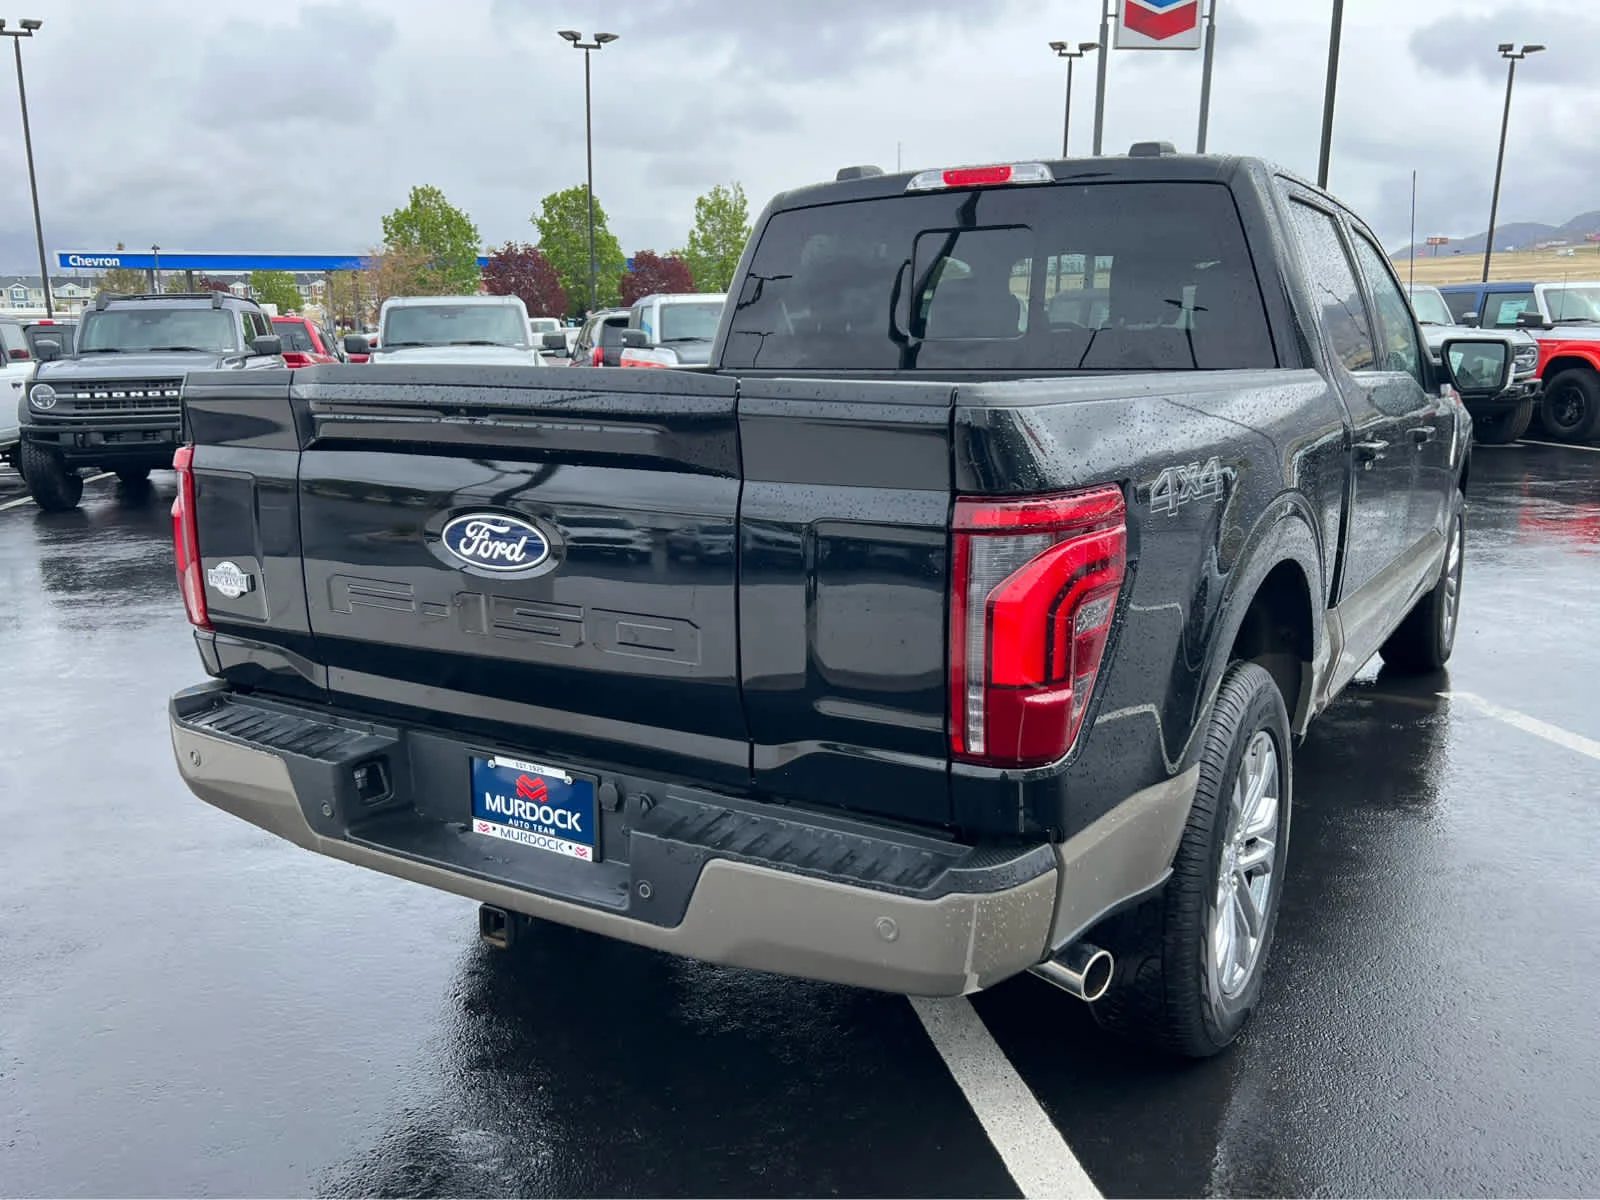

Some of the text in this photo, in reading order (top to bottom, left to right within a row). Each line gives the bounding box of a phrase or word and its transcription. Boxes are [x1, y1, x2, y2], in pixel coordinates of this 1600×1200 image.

[68, 254, 121, 267] Chevron
[459, 521, 527, 563] Ford
[327, 573, 700, 667] F-150
[485, 791, 582, 832] MURDOCK
[508, 818, 556, 835] AUTO TEAM
[500, 826, 564, 852] MURDOCK
